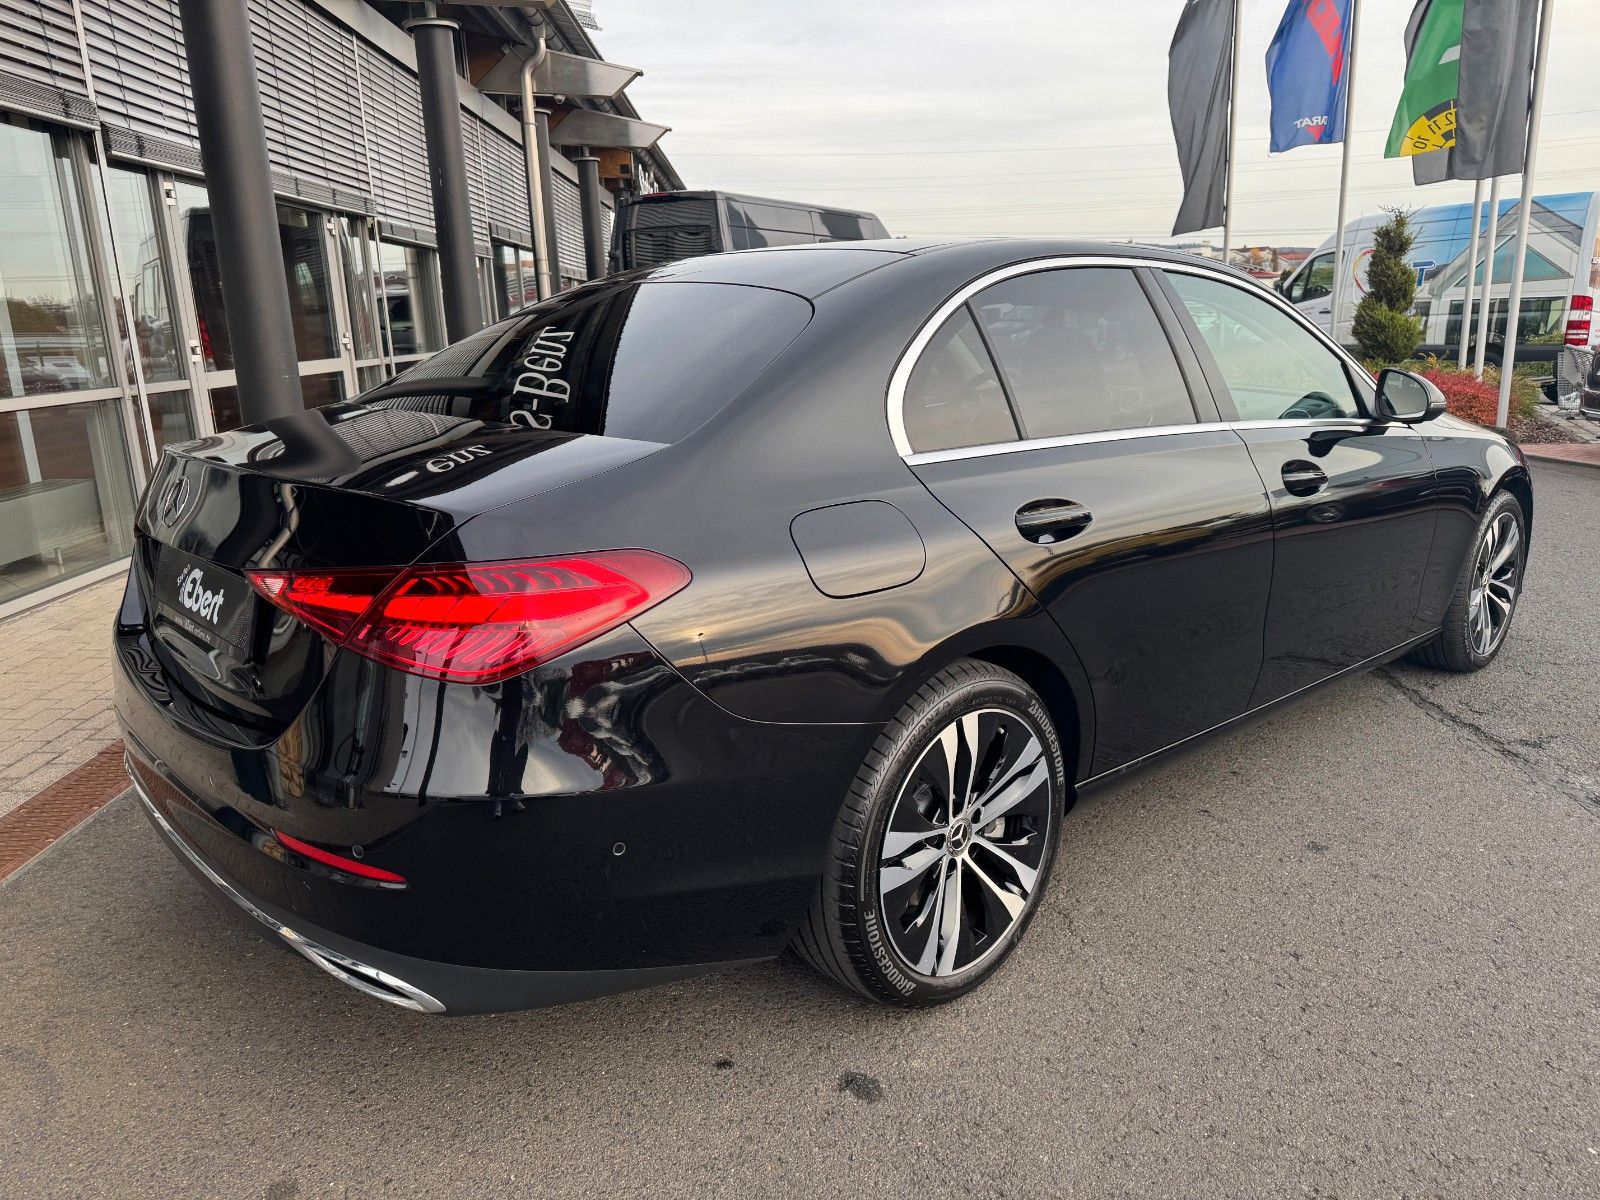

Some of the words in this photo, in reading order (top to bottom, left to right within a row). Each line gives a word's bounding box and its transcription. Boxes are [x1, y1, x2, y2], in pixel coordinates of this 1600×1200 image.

[183, 568, 225, 625] Ebert
[1028, 699, 1066, 786] BRIDGESTONE
[862, 909, 917, 997] BRIDGESTONE
